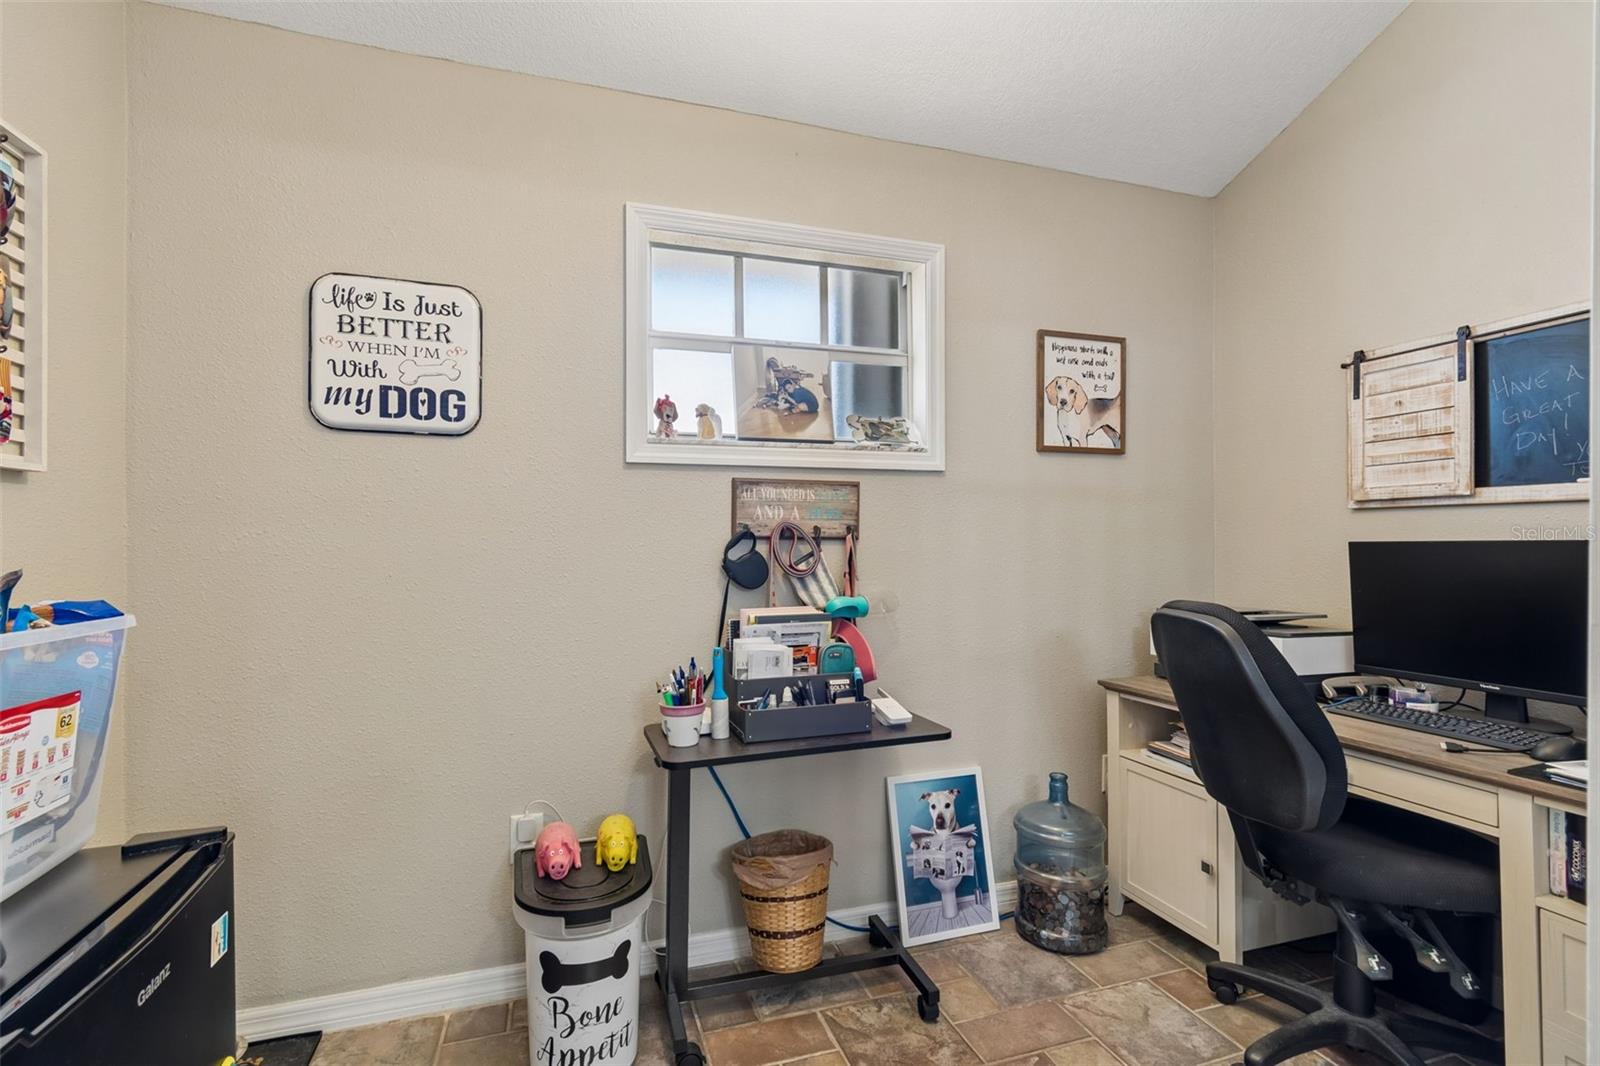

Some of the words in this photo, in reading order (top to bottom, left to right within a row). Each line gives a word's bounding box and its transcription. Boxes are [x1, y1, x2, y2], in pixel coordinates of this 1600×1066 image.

[382, 291, 405, 311] Is
[414, 295, 463, 317] Just
[337, 314, 452, 344] BETTER
[348, 340, 407, 356] WHEN
[414, 347, 440, 359] I'M
[327, 358, 387, 379] With
[1492, 370, 1550, 400] HAVE
[1567, 364, 1585, 382] A
[324, 385, 374, 415] my
[379, 384, 466, 422] DOG
[1502, 392, 1581, 425] GREAT
[753, 505, 784, 520] AND
[791, 505, 800, 520] A
[60, 714, 72, 728] 62
[137, 962, 171, 1006] Galanz
[547, 996, 623, 1039] Bone
[537, 1019, 633, 1066] Appetit
